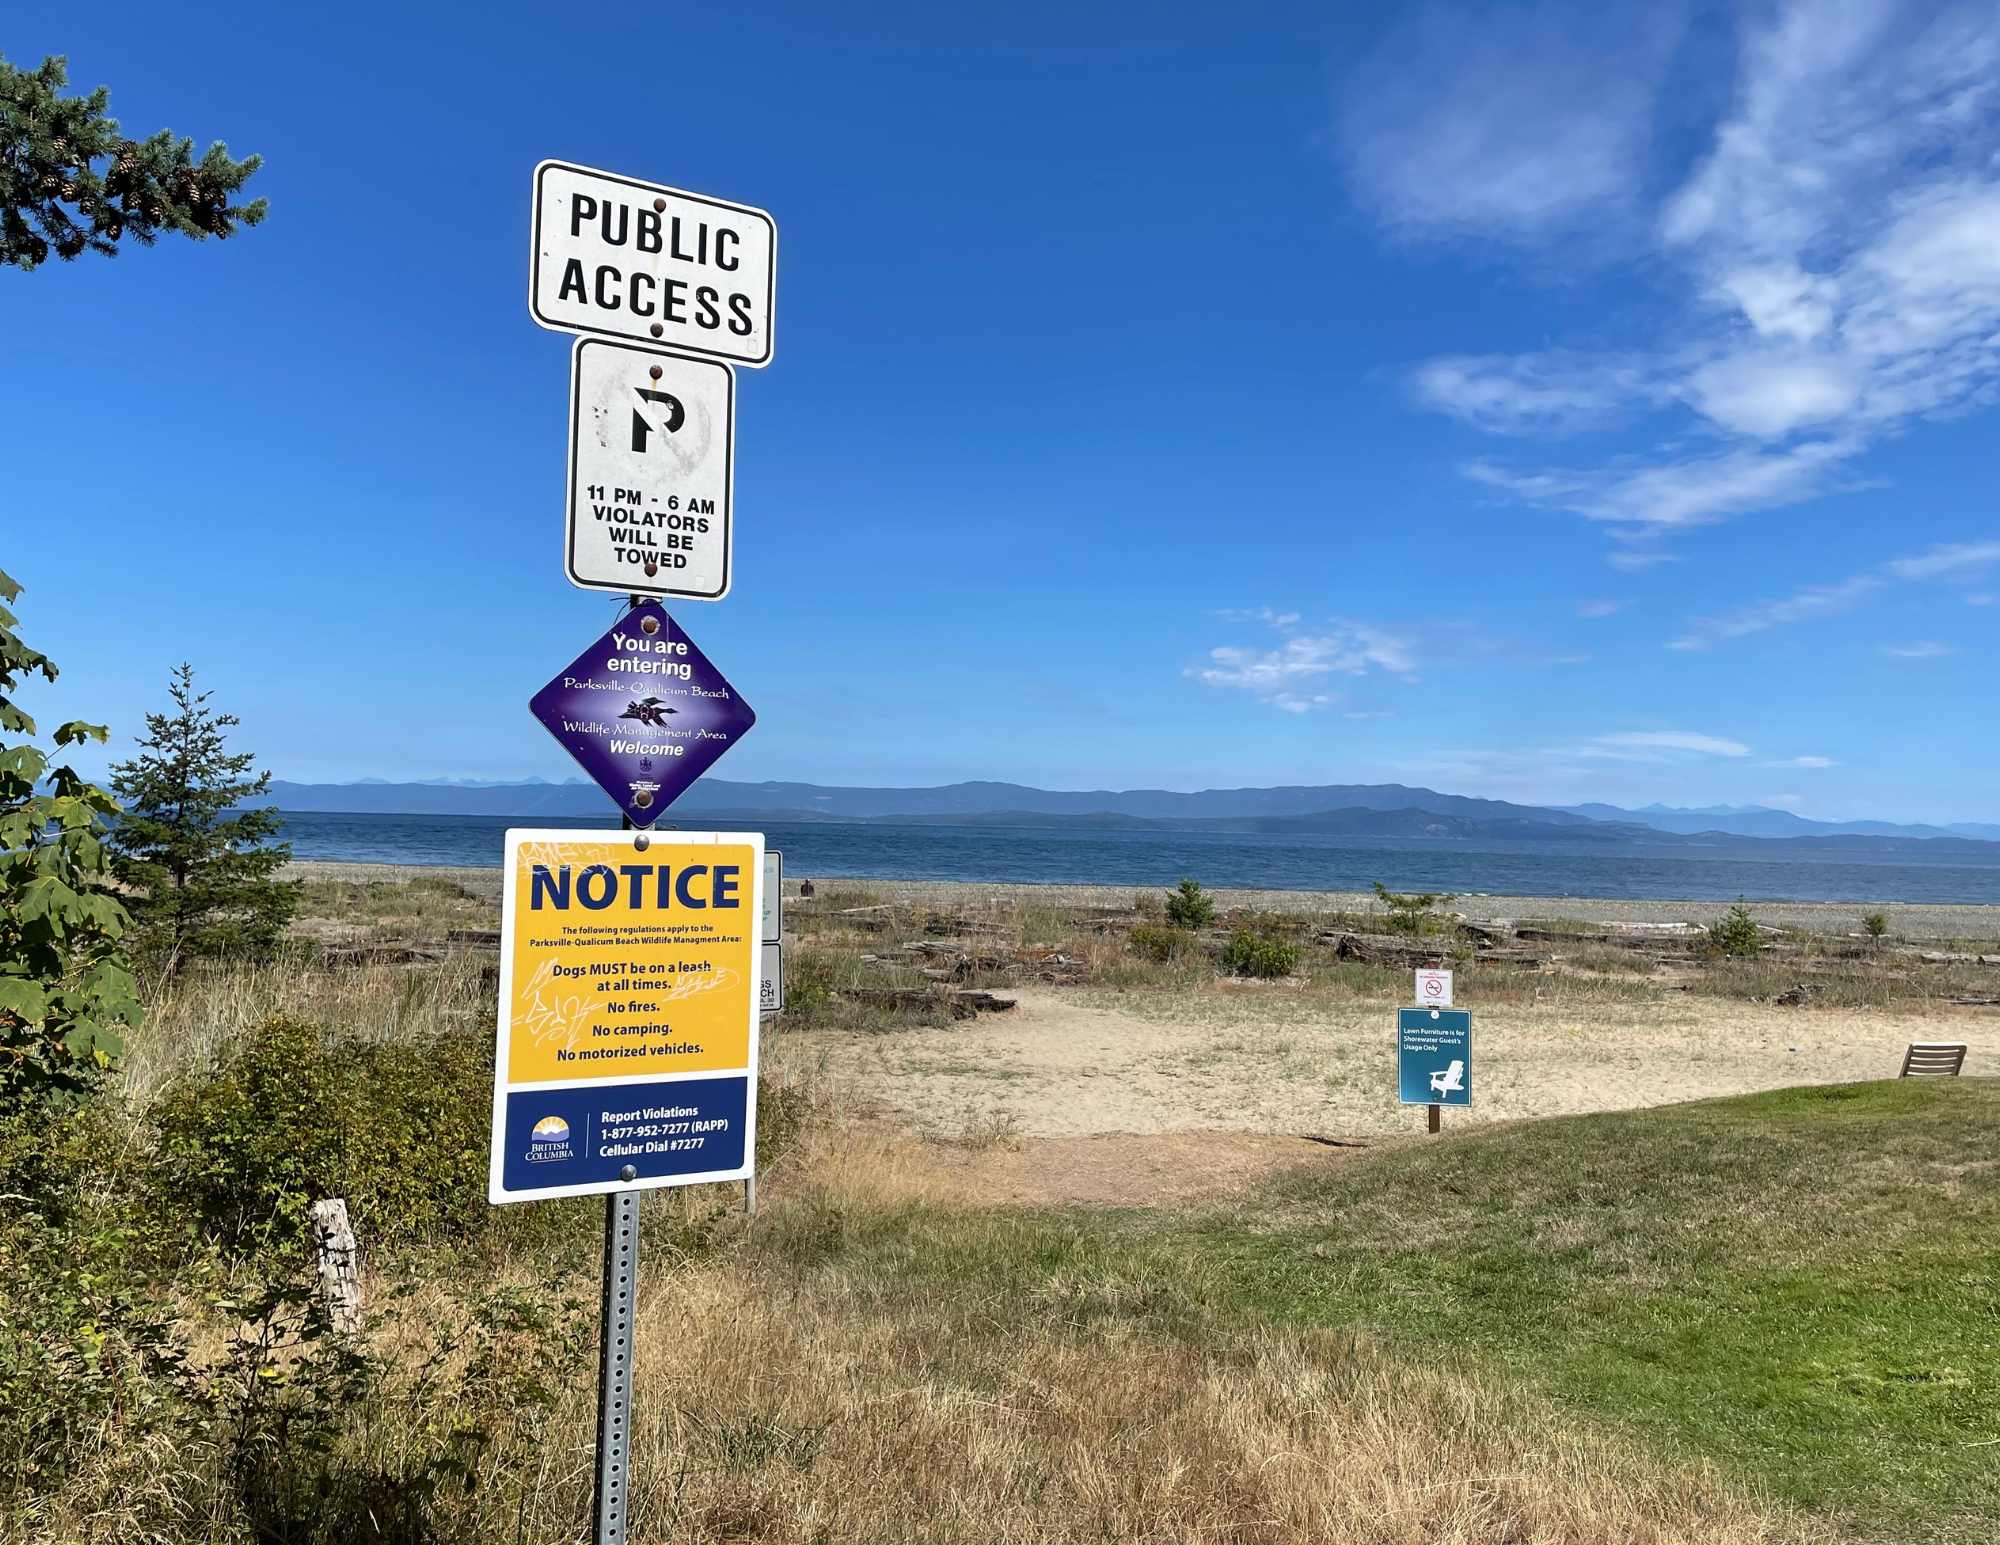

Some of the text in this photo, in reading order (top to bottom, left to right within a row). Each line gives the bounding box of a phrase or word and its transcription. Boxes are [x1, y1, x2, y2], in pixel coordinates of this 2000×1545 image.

[571, 193, 740, 271] PUBLIC
[558, 257, 752, 336] ACCESS
[587, 485, 605, 500] 11
[614, 488, 641, 505] PM
[667, 496, 679, 510] 6
[687, 498, 714, 515] AM
[593, 505, 709, 533] VIOLATORS
[608, 527, 693, 551] WILL BE
[614, 548, 687, 569] TOWED
[612, 633, 687, 655] You are
[607, 656, 692, 680] entering
[563, 677, 729, 699] Parksville-Qualicum Beach
[563, 720, 727, 740] Wildlife Management Area
[609, 740, 684, 756] Welcome
[530, 864, 740, 911] NOTICE
[562, 926, 578, 935] The
[579, 926, 618, 936] following
[619, 926, 666, 936] regulations
[666, 925, 690, 934] apply
[700, 924, 714, 933] the
[530, 938, 614, 947] Parksville-Qualicum
[615, 937, 640, 945] Beach
[641, 936, 672, 945] Wildlife
[673, 935, 720, 945] Managment
[552, 960, 712, 979] Dogs MUST be on a leash
[596, 977, 672, 992] at all times.
[607, 1000, 660, 1013] No fires.
[592, 1021, 673, 1037] No camping.
[1403, 1027, 1420, 1035] Lawn
[1420, 1028, 1449, 1036] Furniture
[1456, 1029, 1465, 1037] for
[1403, 1035, 1438, 1043] Shorewater
[1423, 1044, 1438, 1052] Only
[557, 1043, 704, 1062] No motorized vehicles.
[601, 1106, 699, 1125] Report Violations
[601, 1118, 729, 1141] 1-877-952-7277 (RAPP)
[525, 1150, 574, 1162] COLUMBIA
[531, 1141, 569, 1153] BRITISH
[599, 1137, 705, 1158] Cellular Dial #7277
